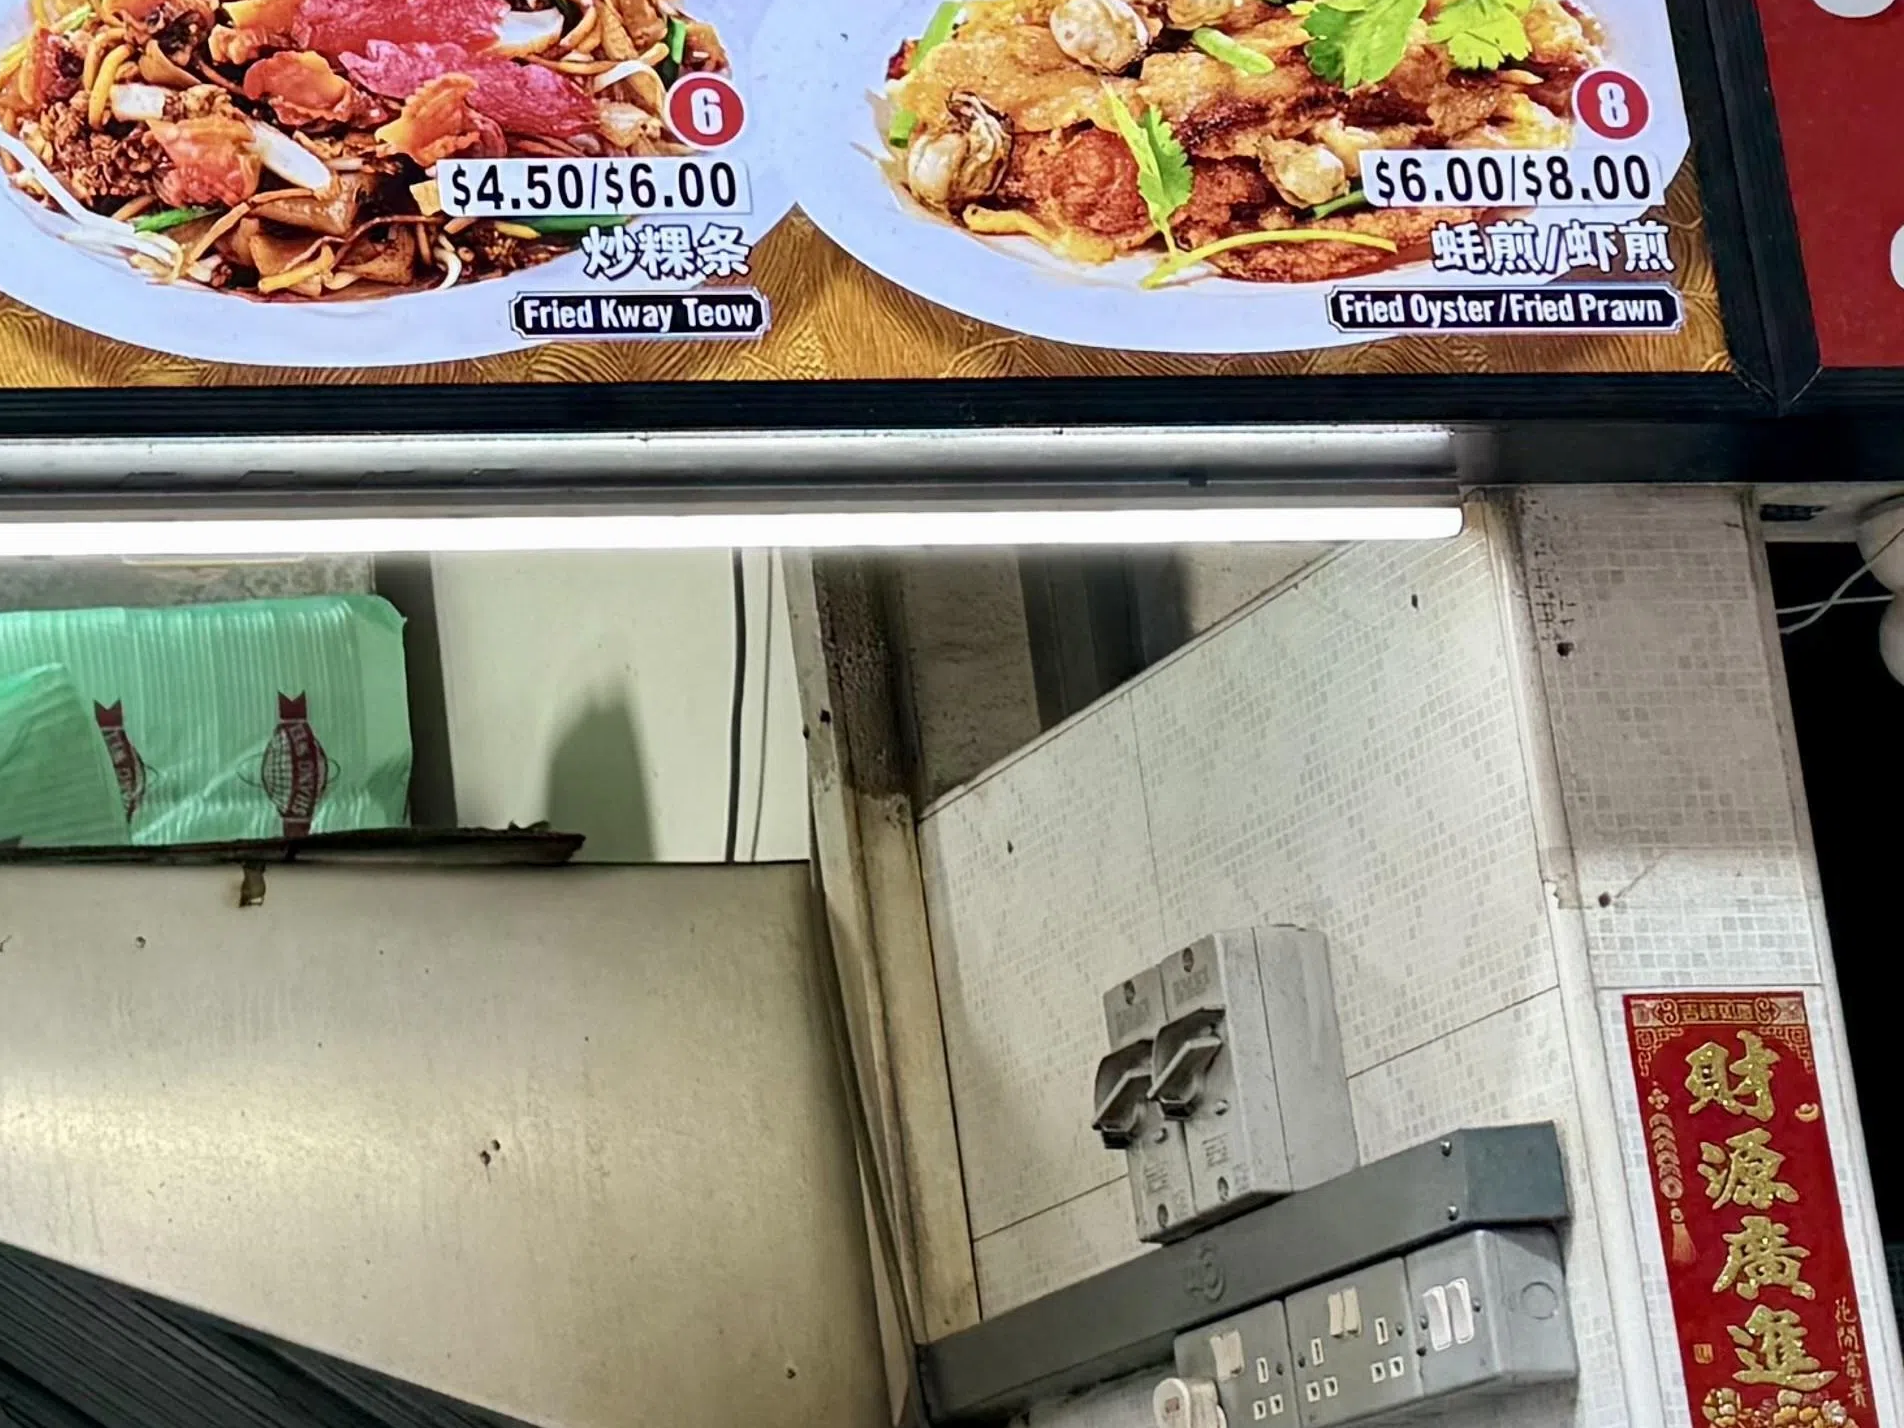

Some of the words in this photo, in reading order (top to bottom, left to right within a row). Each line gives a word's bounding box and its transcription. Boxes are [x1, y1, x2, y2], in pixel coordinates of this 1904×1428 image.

[690, 87, 725, 135] 6
[1597, 81, 1630, 129] 8
[452, 161, 737, 214] $4.50/$6.00
[1376, 155, 1650, 208] $6.00/$8.00
[580, 223, 753, 280] 炒粿条
[1430, 219, 1676, 274] 蚝煎/虾煎
[523, 299, 593, 329] Fried
[600, 298, 673, 333] Kway
[682, 298, 754, 327] Teow
[1339, 294, 1404, 323] Fried
[1410, 294, 1494, 329] Oyster
[1500, 294, 1575, 323] /Fried
[1579, 297, 1663, 322] Prawn
[1684, 1030, 1839, 1392] 財源廣進
